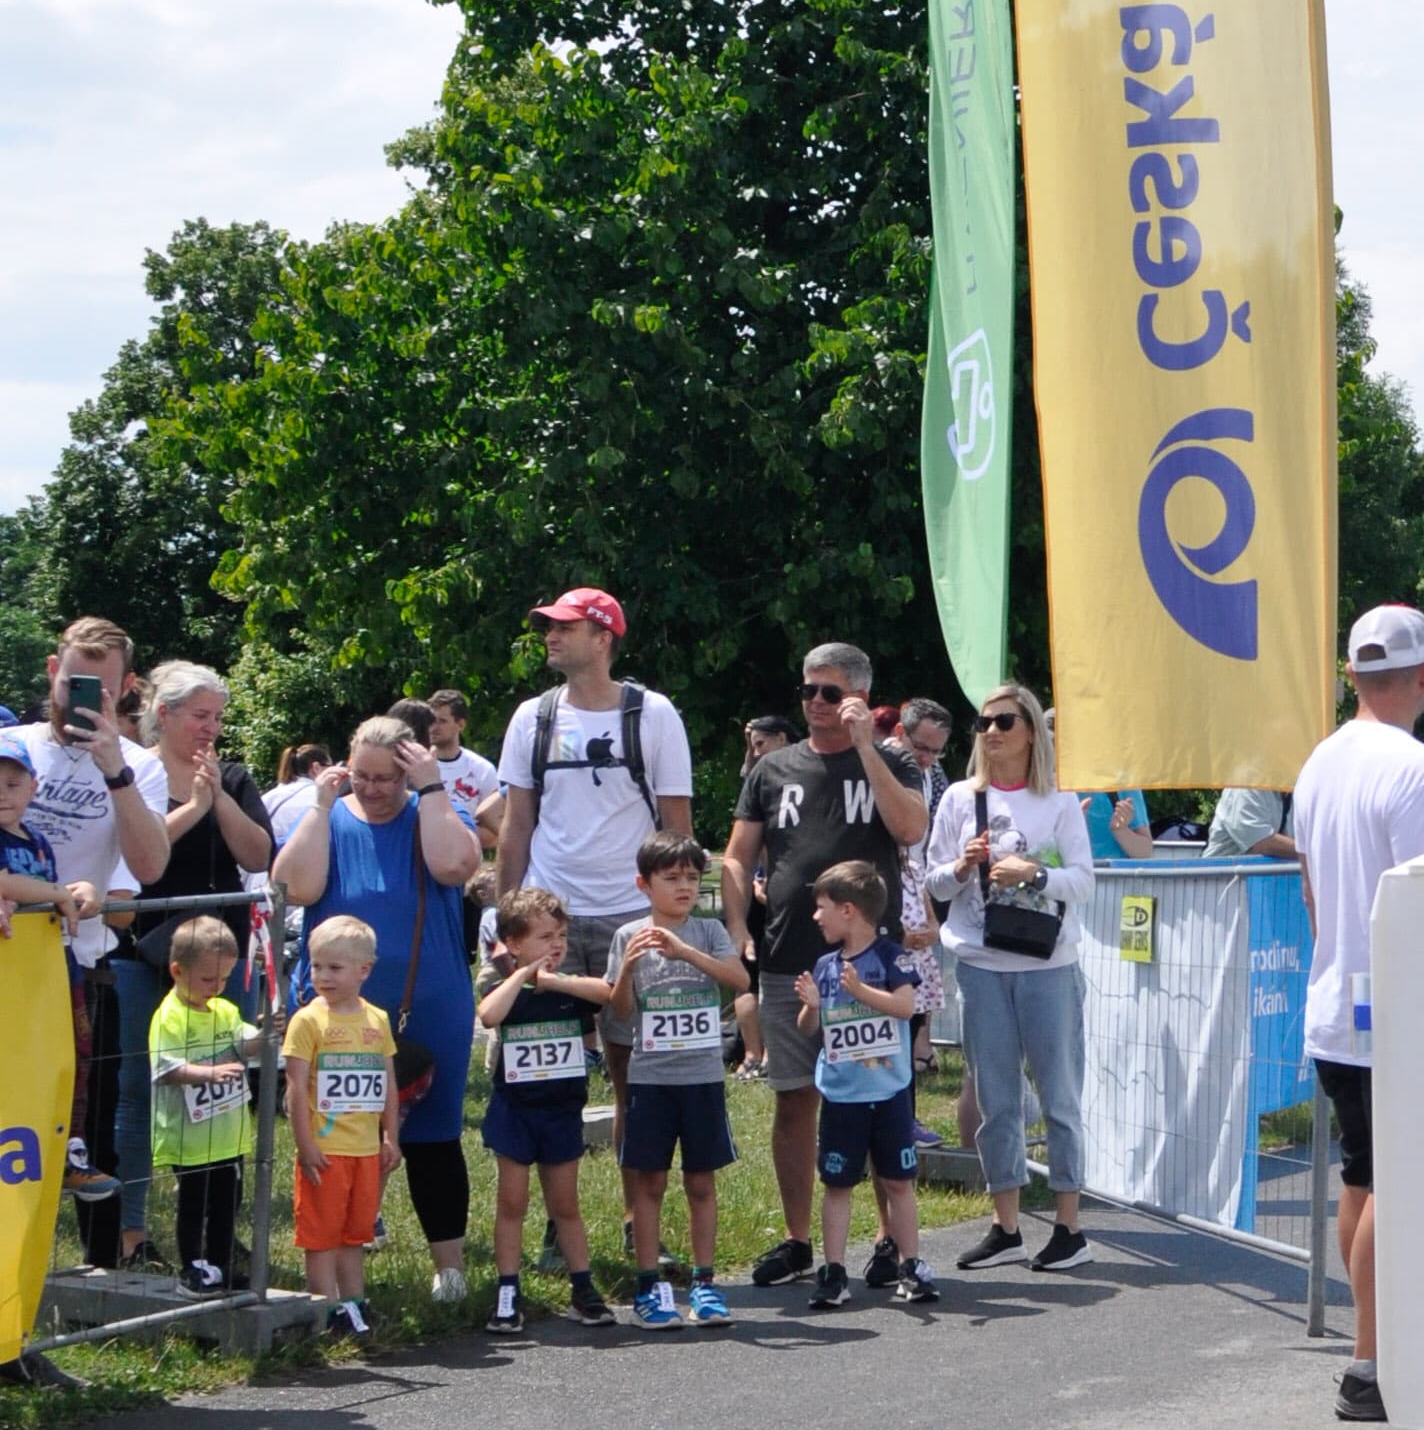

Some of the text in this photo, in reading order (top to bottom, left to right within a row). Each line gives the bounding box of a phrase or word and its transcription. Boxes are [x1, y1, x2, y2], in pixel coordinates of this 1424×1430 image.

[652, 1012, 710, 1038] 2136
[830, 1019, 893, 1050] 2004
[515, 1041, 572, 1068] 2137
[326, 1074, 383, 1098] 2076
